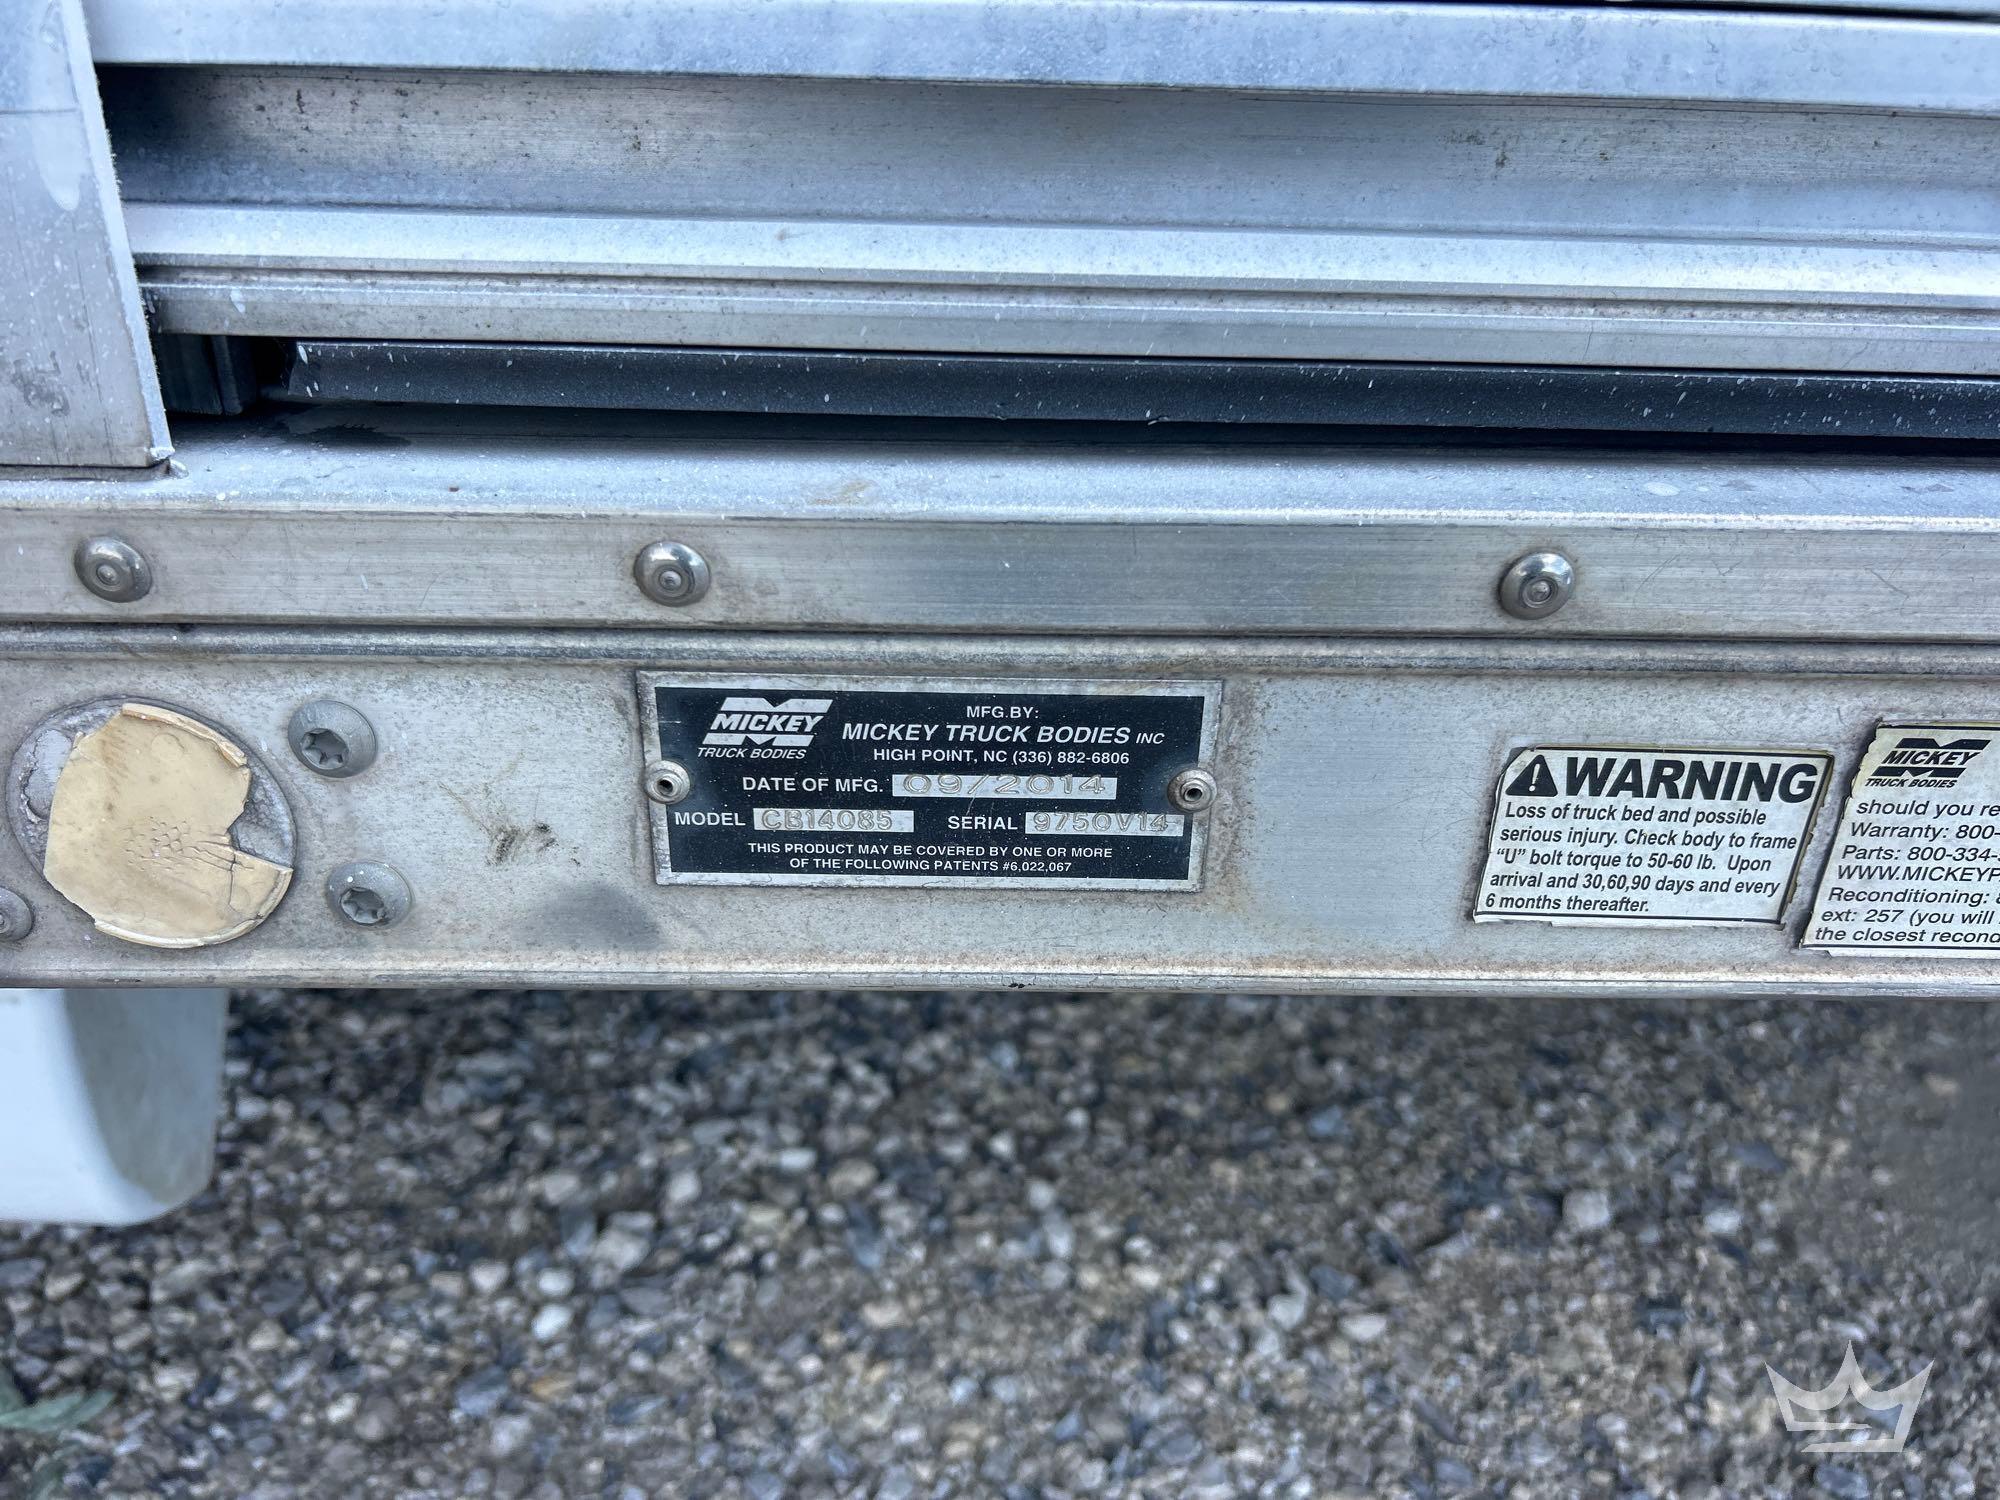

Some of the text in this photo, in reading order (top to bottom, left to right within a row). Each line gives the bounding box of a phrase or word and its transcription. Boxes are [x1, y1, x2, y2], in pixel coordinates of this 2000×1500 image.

[710, 714, 824, 732] MICKEY
[842, 723, 1165, 744] MICKEY TRUCK BODIES INC
[698, 748, 807, 759] TRUCK BODIES
[873, 749, 1130, 765] HIGH POINT, NC (336) 882-6806
[1881, 750, 1981, 766] MICKEY
[742, 774, 1105, 795] DATE OF MFG. 09/2014
[1565, 756, 1818, 803] WARNING
[1865, 778, 1958, 788] TRUCK BODIES
[1505, 801, 1767, 827] Loss of truck bed and possible
[1856, 800, 1930, 815] should
[1933, 804, 1974, 819] you
[675, 809, 1169, 832] MODEL CB14085 SERIAL 9750V14
[1500, 826, 1797, 850] serious injury. Check body to frame
[1851, 822, 1949, 842] Warranty:
[748, 843, 1113, 858] THIS PRODUCT MAY BE COVERED BY ONE OR MORE
[1842, 845, 2000, 862] Parts: 800-334-
[789, 858, 1072, 872] OF THE FOLLOWING PATENTS #6,022,067
[1529, 850, 1563, 866] bolt
[1566, 852, 1621, 870] torque
[1626, 852, 1643, 868] to
[1647, 853, 1693, 869] 50-60
[1696, 854, 1716, 870] lb.
[1727, 855, 1772, 874] Upon
[1490, 872, 1780, 897] arrival and 30,60,90 days and every
[1485, 893, 1649, 912] 6 months thereafter.
[1828, 888, 1990, 908] Reconditioning:
[1821, 909, 1995, 926] ext: 257 (you will
[1815, 927, 1846, 940] the
[1852, 928, 1926, 942] closest
